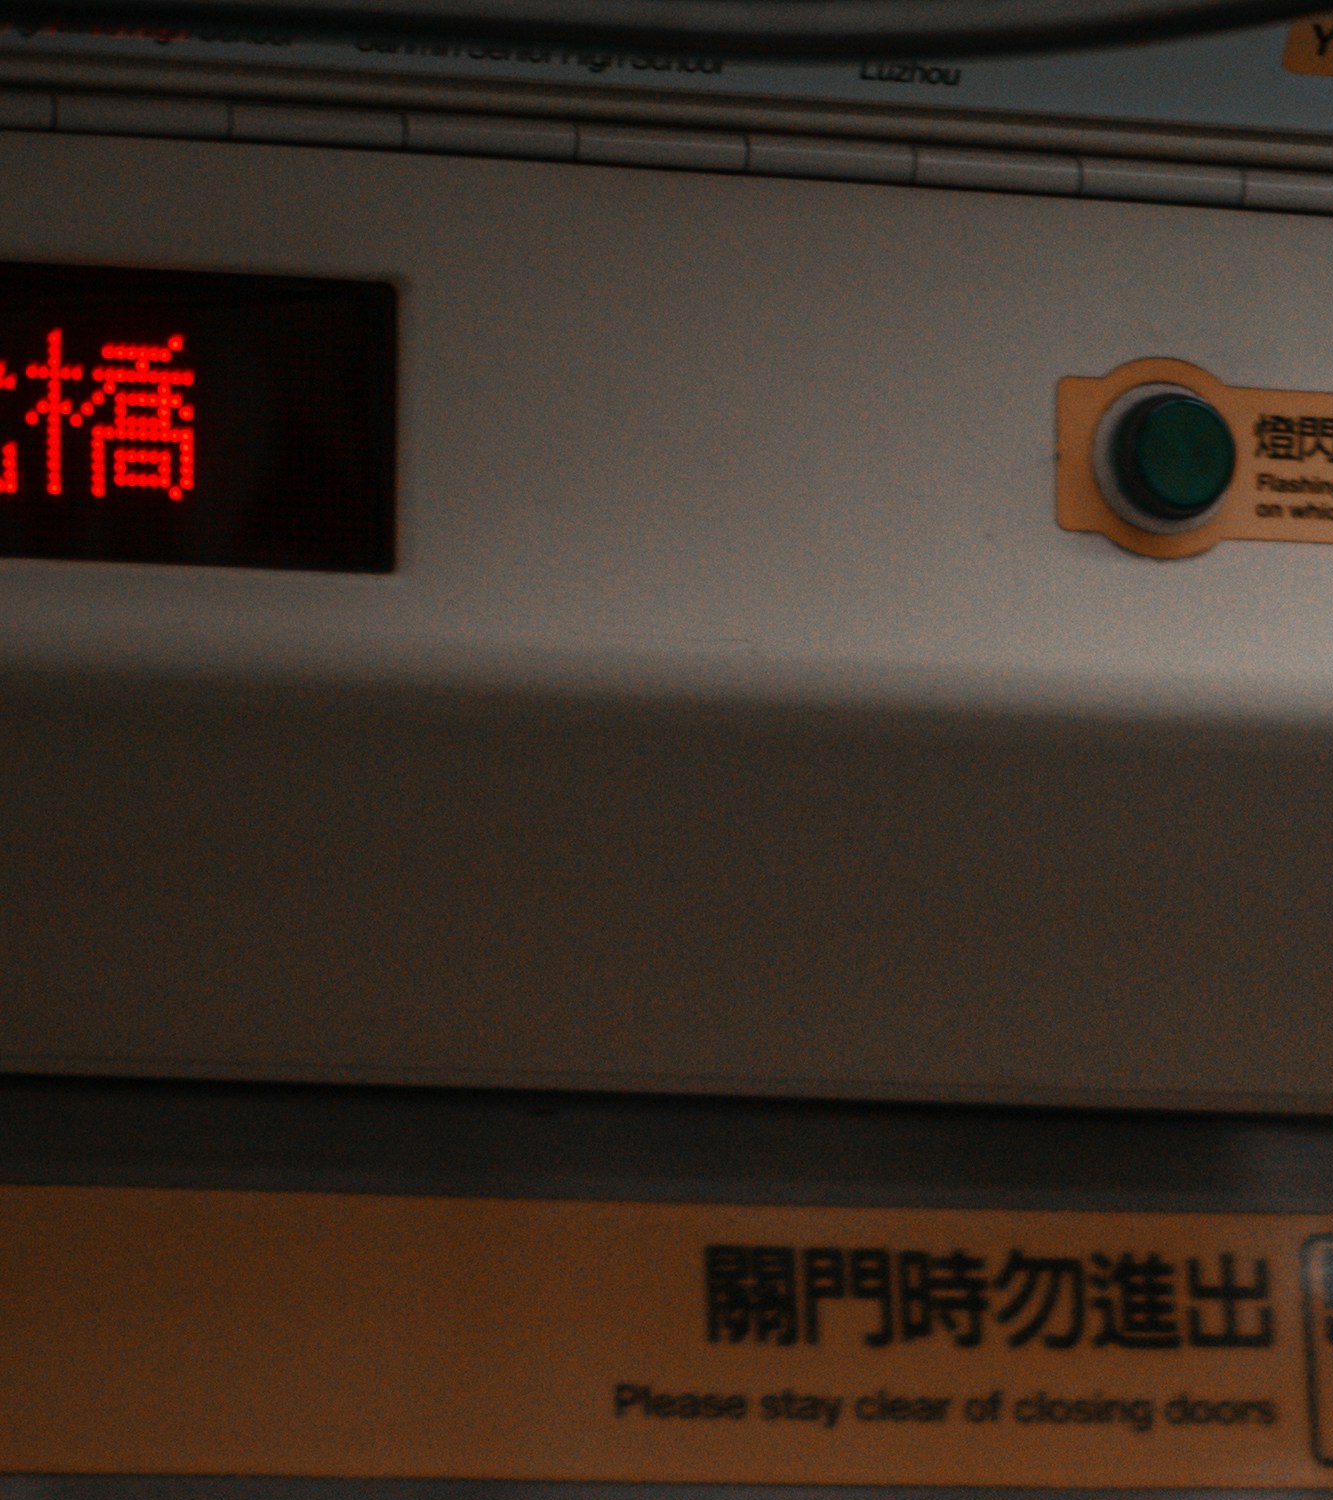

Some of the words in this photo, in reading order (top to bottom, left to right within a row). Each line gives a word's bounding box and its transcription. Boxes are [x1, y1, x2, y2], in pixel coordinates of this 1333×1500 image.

[860, 57, 962, 86] Luzhou
[0, 328, 194, 500] 橋
[1255, 503, 1284, 519] on
[703, 1243, 1275, 1350] 關門時勿進出
[614, 1383, 747, 1422] Please
[760, 1388, 842, 1428] stay
[854, 1389, 951, 1424] clear
[962, 1391, 1004, 1426] of
[1011, 1392, 1155, 1432] closing
[1162, 1394, 1279, 1427] doors
